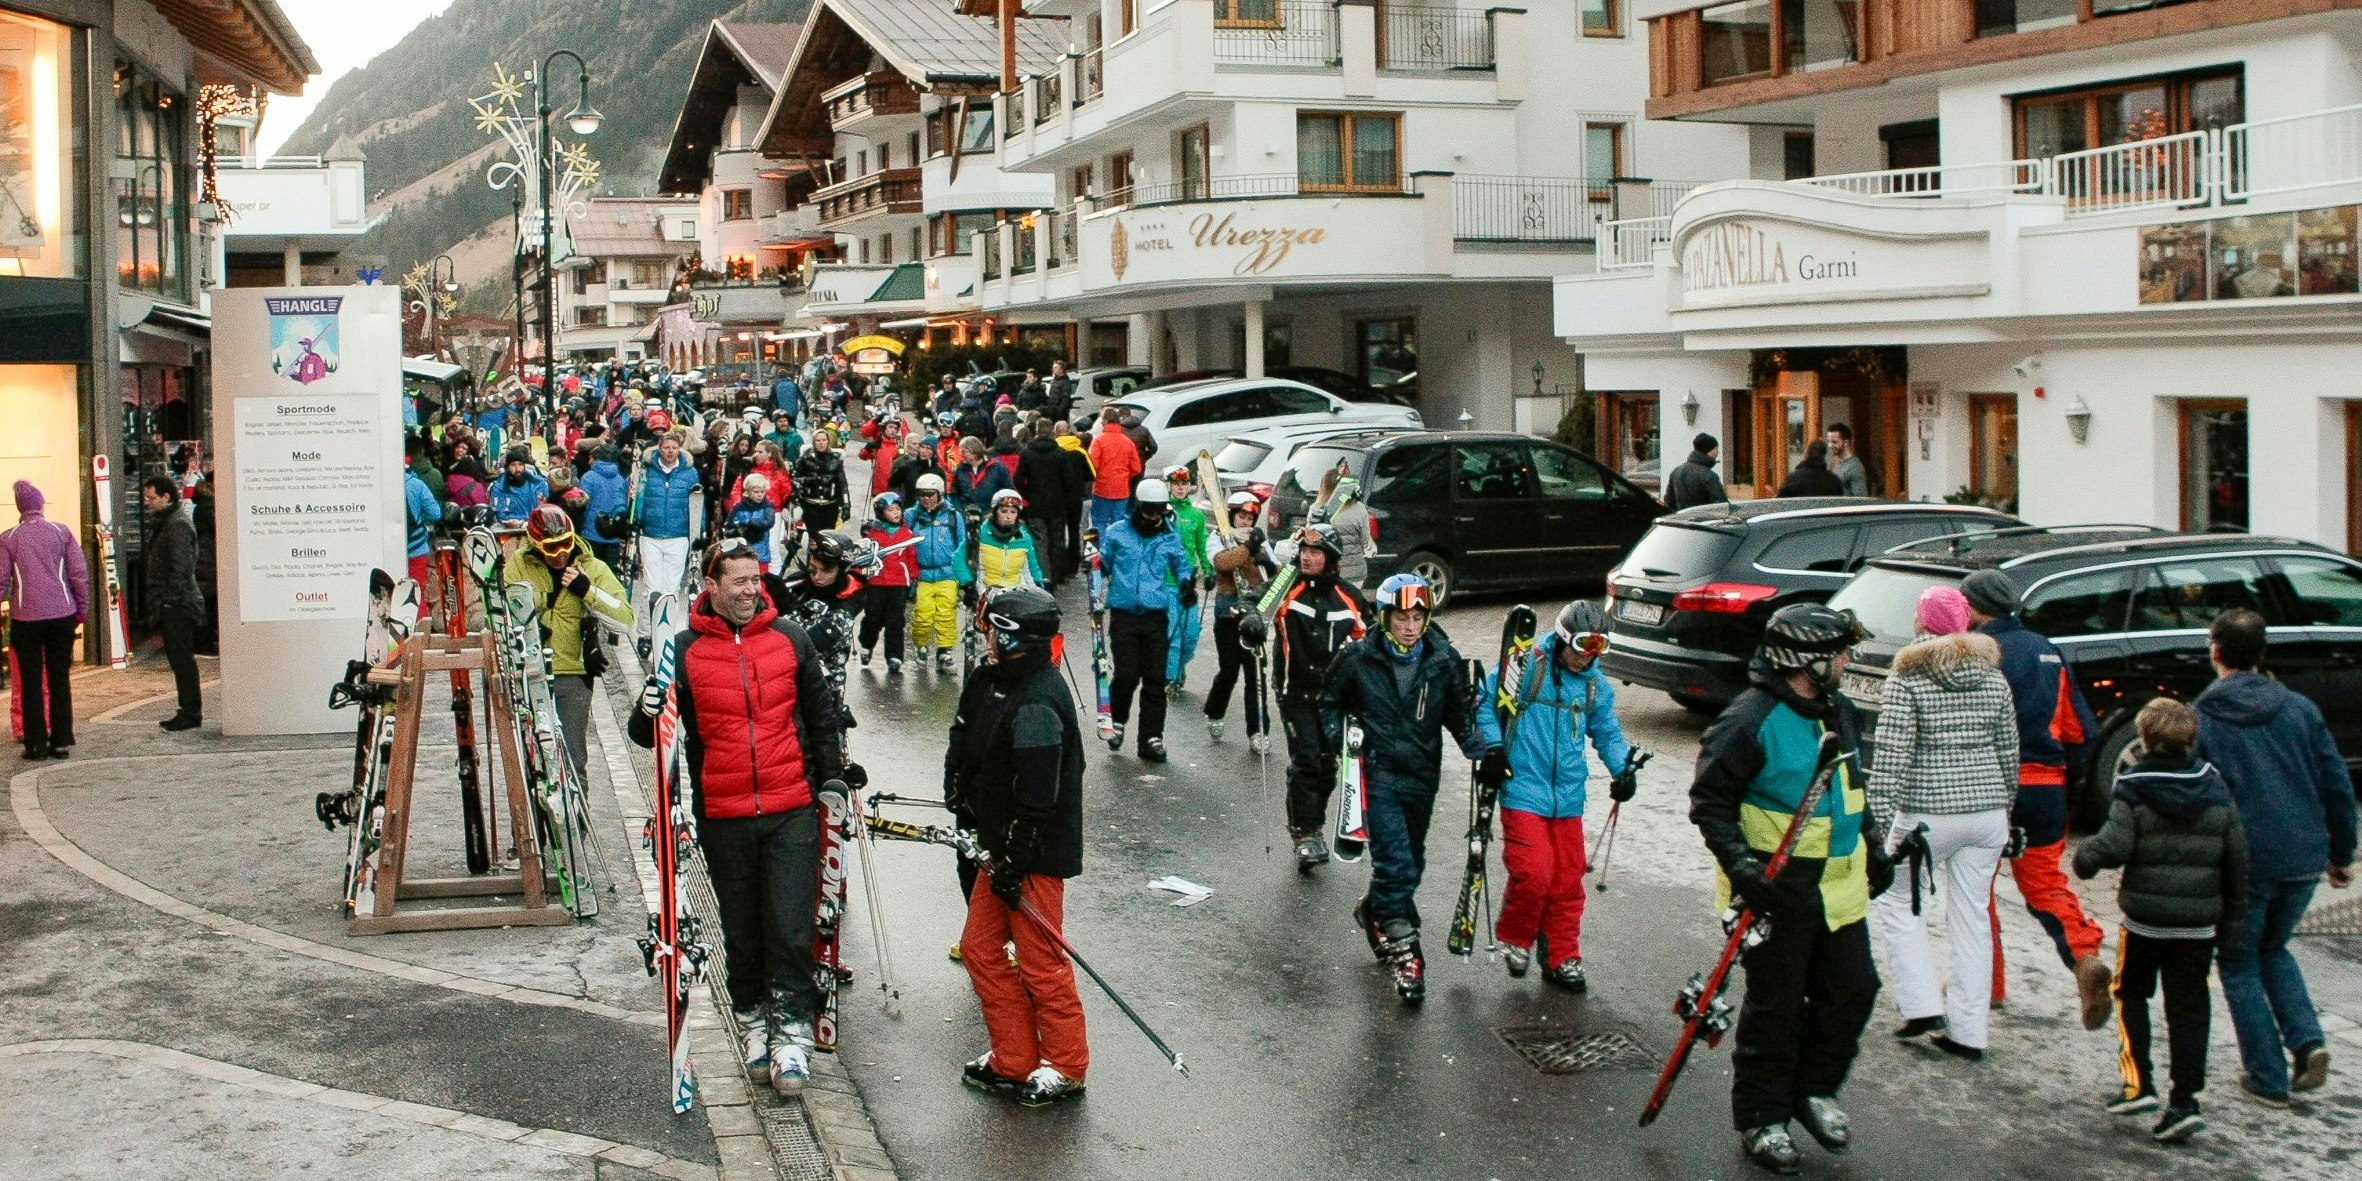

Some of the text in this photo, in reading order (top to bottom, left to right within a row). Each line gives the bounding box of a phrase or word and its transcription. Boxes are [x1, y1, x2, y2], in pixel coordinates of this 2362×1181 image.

[1135, 211, 1326, 275] HOTEL Urezza
[1799, 251, 1857, 280] Garni
[280, 300, 328, 313] HANGL
[276, 404, 337, 416] Sportmode
[291, 451, 321, 460] Mode
[250, 502, 366, 515] Schuhe & Accessoire
[291, 547, 327, 557] Brillen
[295, 591, 329, 601] Outlet
